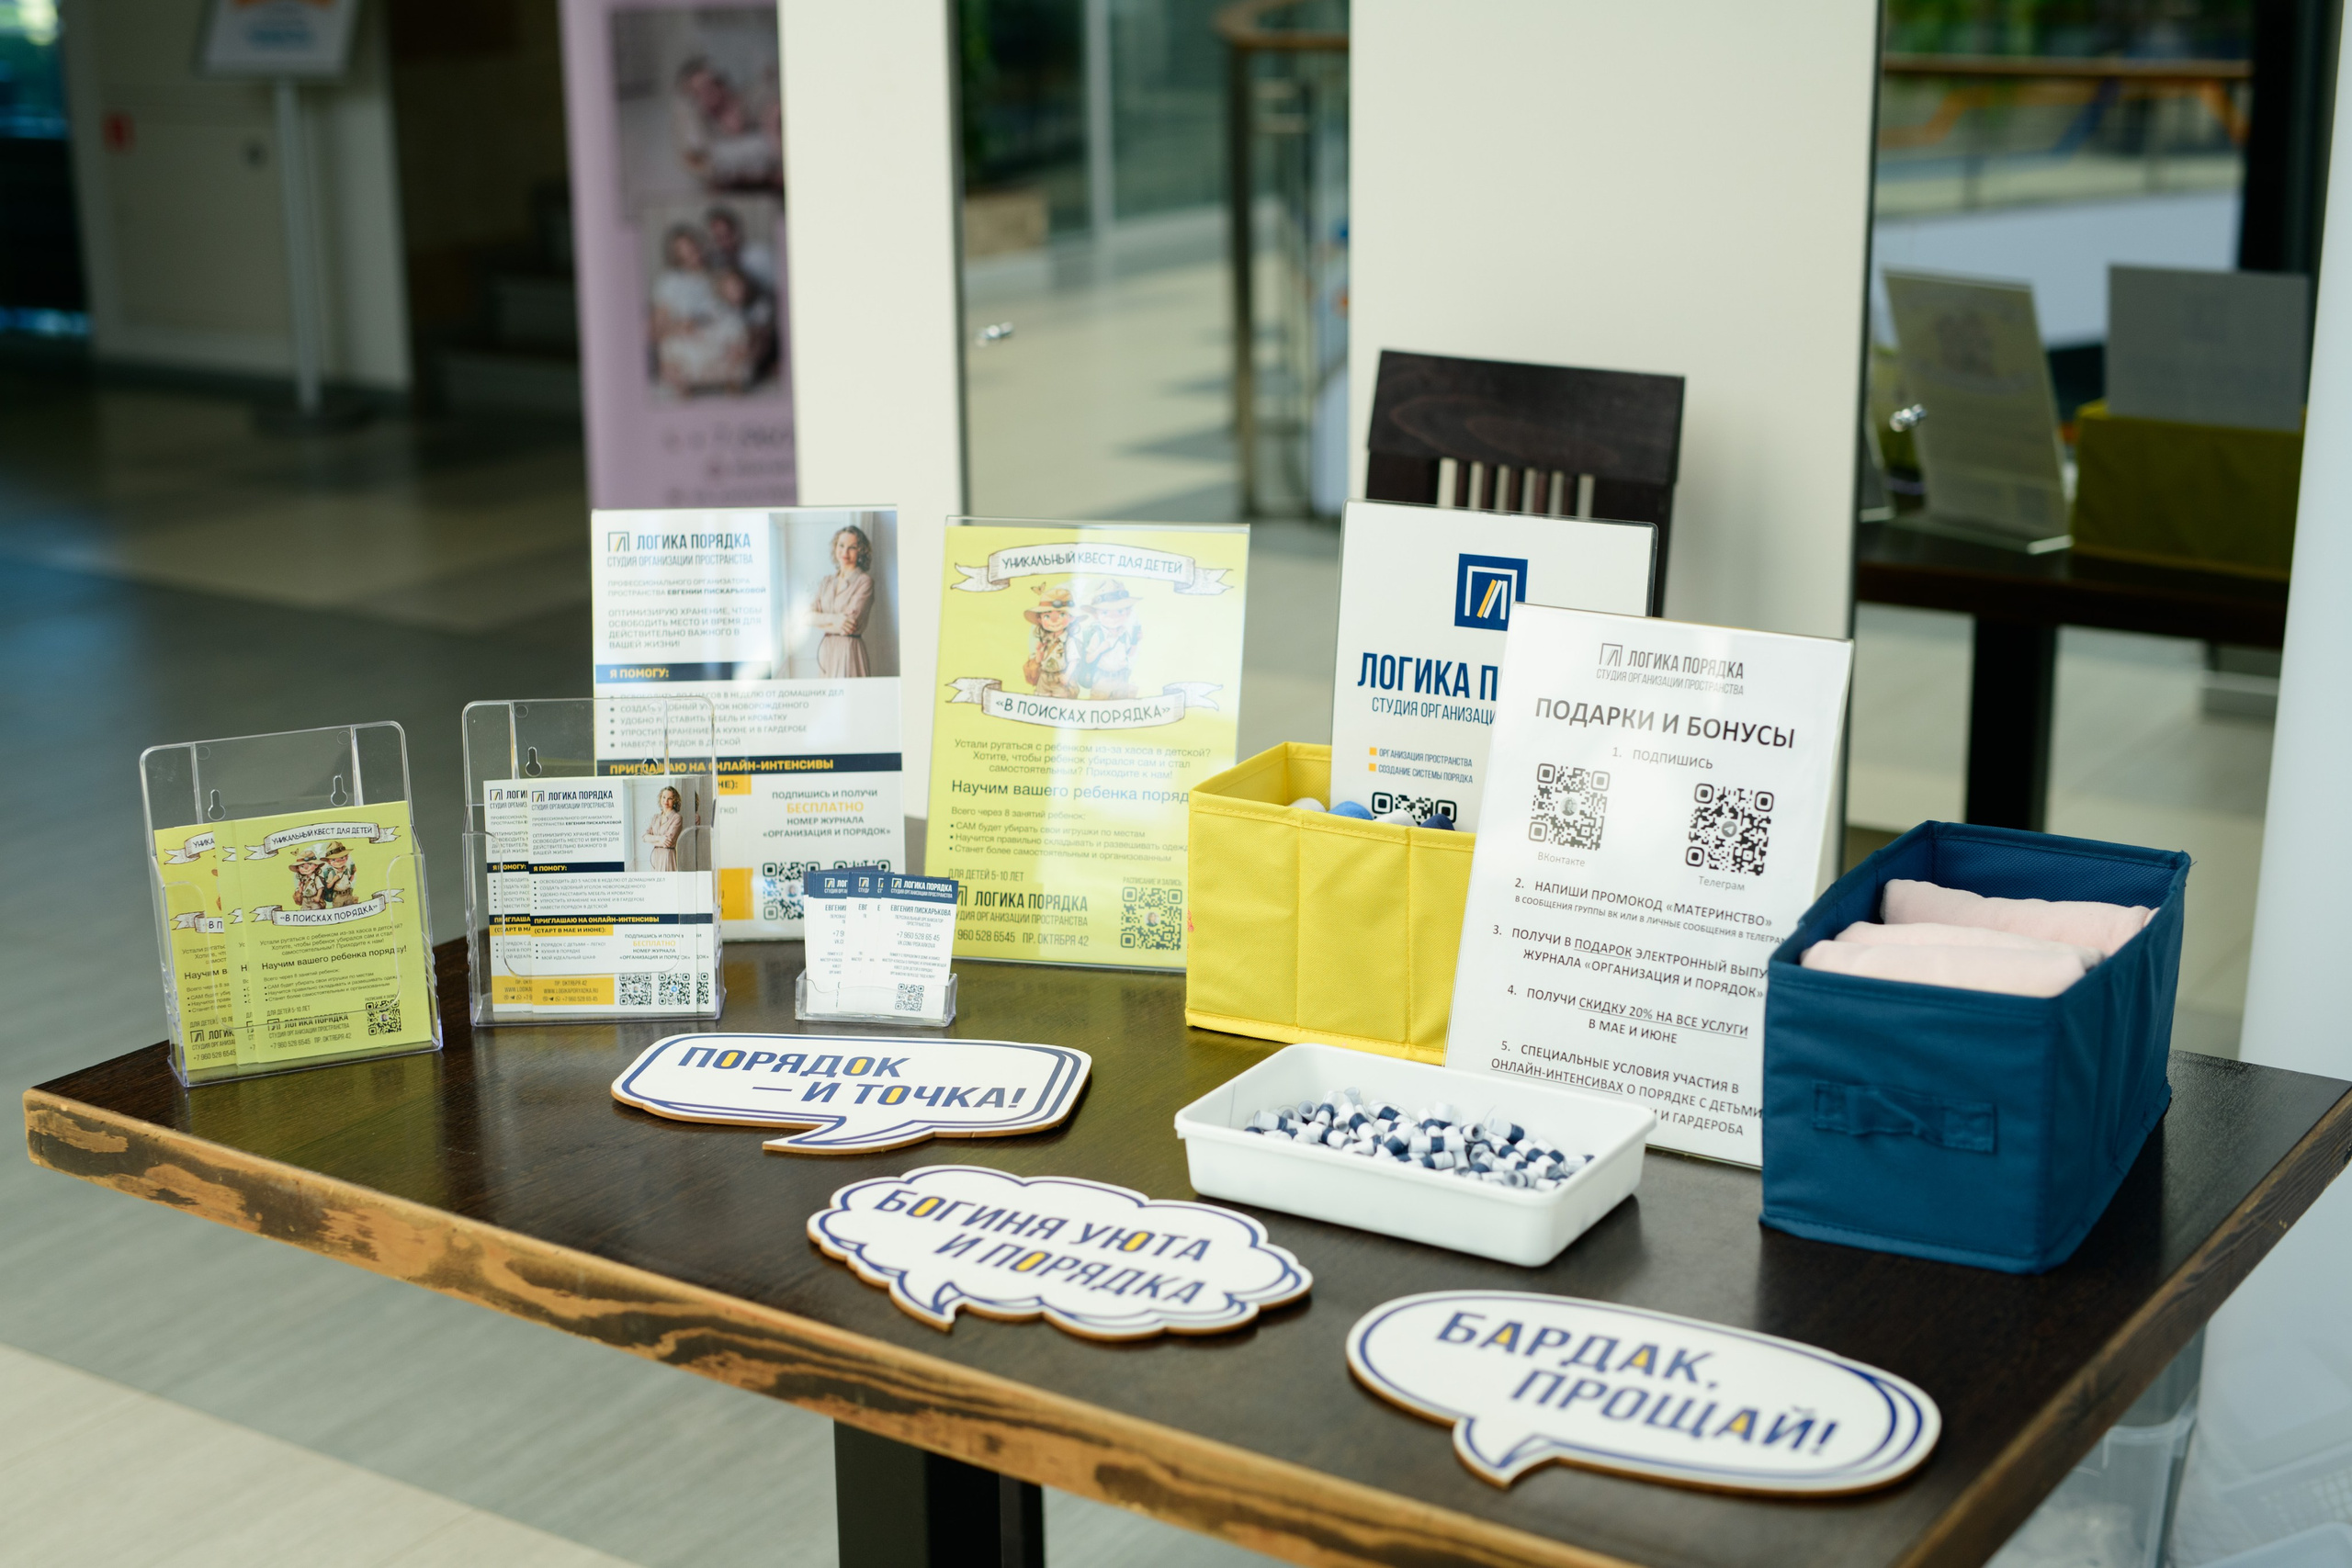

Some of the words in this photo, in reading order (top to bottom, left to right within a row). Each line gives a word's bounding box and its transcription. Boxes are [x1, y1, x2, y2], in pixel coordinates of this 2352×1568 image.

[637, 534, 686, 550] ЛОГИКА
[692, 533, 751, 549] ПОРЯДКА
[607, 556, 637, 568] СТУДИЯ
[639, 555, 693, 567] ОРГАНИЗАЦИИ
[695, 555, 752, 566] ПРОСТРАНСТВА
[1002, 551, 1075, 570] УНИКАЛЬНЫЙ
[1078, 552, 1114, 566] КВЕСТ
[1117, 556, 1142, 570] ДЛЯ
[1145, 558, 1182, 574] ДЕТЕЙ
[610, 670, 617, 678] Я
[620, 668, 669, 678] ПОМОГУ:
[1358, 652, 1470, 699] ЛОГИКА
[1628, 650, 1679, 672] ЛОГИКА
[1682, 656, 1743, 680] ПОРЯДКА
[1597, 669, 1626, 682] СТУДИЯ
[1628, 672, 1683, 688] ОРГАНИЗАЦИИ
[1685, 679, 1743, 695] ПРОСТРАНСТВА
[996, 698, 1013, 711] «В
[1017, 701, 1086, 723] ПОИСКАХ
[1091, 706, 1170, 724] ПОРЯДКА»
[1372, 697, 1418, 716] СТУДИЯ
[1420, 703, 1496, 726] ОРГАНИЗАЦИ
[1535, 698, 1654, 731] ПОДАРКИ
[1662, 713, 1678, 734] И
[1687, 716, 1794, 748] БОНУСЫ
[689, 762, 706, 773] НА
[1379, 748, 1423, 761] ОРГАНИЗАЦИЯ
[1425, 753, 1472, 767] ПРОСТРАНСТВА
[1612, 747, 1622, 758] 1.
[1634, 750, 1713, 769] ПОДПИШИСЬ
[1378, 764, 1410, 776] СОЗДАНИЕ
[1412, 768, 1442, 780] СИСТЕМЫ
[1443, 772, 1473, 784] ПОРЯДКА
[548, 792, 577, 800] ЛОГИКА
[579, 791, 613, 800] ПОРЯДКА
[772, 791, 830, 799] ПОДПИШИСЬ
[952, 780, 1008, 796] Научим
[1013, 784, 1068, 796] вашего
[1074, 786, 1136, 801] ребенка
[1142, 789, 1189, 804] поряд
[786, 802, 864, 813] БЕСПЛАТНО
[272, 829, 314, 844] УНИКАЛЬНЫЙ
[314, 827, 335, 836] КВЕСТ
[352, 826, 372, 834] ДЕТЕЙ
[763, 829, 831, 838] «ОРГАНИЗАЦИЯ
[834, 829, 841, 837] И
[843, 828, 890, 837] ПОРЯДОК»
[1538, 852, 1585, 867] ВКонтакте
[904, 881, 925, 889] ЛОГИКА
[926, 883, 952, 892] ПОРЯДКА
[948, 869, 964, 879] ДЛЯ
[966, 870, 989, 880] ДЕТЕЙ
[991, 871, 1010, 881] 5-10
[1012, 871, 1023, 881] ЛЕТ
[1699, 875, 1745, 892] Телеграм
[890, 905, 913, 913] ЕВГЕНИЯ
[914, 907, 951, 916] ПИСКАРЬКОВА
[975, 891, 1023, 908] ЛОГИКА
[1029, 894, 1088, 911] ПОРЯДКА
[1515, 878, 1524, 889] 2.
[1535, 881, 1588, 899] НАПИШИ
[1591, 889, 1662, 910] ПРОМОКОД
[1667, 900, 1771, 927] «МАТЕРИНСТВО»
[280, 914, 290, 922] «В
[293, 913, 332, 922] ПОИСКАХ
[334, 904, 378, 921] ПОРЯДКА»
[956, 911, 975, 921] УДИЯ
[977, 912, 1029, 924] ОРГАНИЗАЦИИ
[1032, 914, 1088, 926] ПРОСТРАНСТВА
[1522, 897, 1572, 911] СООБЩЕНИЯ
[1575, 905, 1606, 917] ГРУППЫ
[1608, 909, 1618, 919] ВК
[1620, 911, 1636, 921] ИЛИ
[1640, 915, 1645, 923] В
[1646, 916, 1680, 929] ЛИЧНЫЕ
[1683, 921, 1736, 937] СООБЩЕНИЯ
[1738, 930, 1743, 939] В
[957, 930, 974, 941] 960
[976, 931, 991, 942] 528
[994, 931, 1015, 942] 6545
[1023, 932, 1035, 944] ПР.
[1038, 933, 1076, 946] ОКТЯБРЯ
[1079, 935, 1089, 946] 42
[262, 960, 294, 972] Научим
[297, 956, 328, 966] вашего
[332, 950, 366, 964] ребенка
[1493, 925, 1501, 936] 3.
[1511, 928, 1562, 946] ПОЛУЧИ
[1565, 936, 1571, 948] В
[1575, 938, 1632, 957] ПОДАРОК
[1635, 947, 1726, 973] ЭЛЕКТРОННЫЙ
[1730, 963, 1768, 979] ВЫПУ
[1523, 950, 1580, 969] ЖУРНАЛА
[1585, 959, 1679, 985] «ОРГАНИЗАЦИЯ
[1683, 975, 1691, 987] И
[1695, 977, 1763, 998] ПОРЯДОК»
[1508, 985, 1517, 997] 4.
[1527, 988, 1576, 1007] ПОЛУЧИ
[1579, 998, 1626, 1015] СКИДКУ
[1629, 1006, 1652, 1020] 20%
[1657, 1010, 1672, 1023] НА
[1677, 1014, 1698, 1028] ВСЕ
[1702, 1018, 1748, 1036] УСЛУГИ
[1589, 1019, 1595, 1030] В
[1600, 1021, 1625, 1034] МАЕ
[1629, 1025, 1636, 1036] И
[1641, 1028, 1678, 1043] ИЮНЕ
[678, 1046, 910, 1078] ПОРЯДОК
[1501, 1041, 1510, 1052] 5.
[1521, 1044, 1609, 1070] СПЕЦИАЛЬНЫЕ
[1612, 1061, 1668, 1081] УСЛОВИЯ
[1673, 1071, 1727, 1091] УЧАСТИЯ
[1732, 1082, 1738, 1094] В
[801, 1083, 839, 1103] И
[854, 1084, 1027, 1109] ТОЧКА!
[1491, 1058, 1623, 1093] ОНЛАЙН-ИНТЕНСИВАХ
[1627, 1083, 1635, 1095] О
[1639, 1085, 1695, 1107] ПОРЯДКЕ
[1700, 1096, 1706, 1109] С
[1709, 1098, 1762, 1119] ДЕТЬМИ
[1661, 1110, 1668, 1121] И
[1673, 1112, 1743, 1136] ГАРДЕРОБА
[874, 1189, 1069, 1240] БОГИНЯ
[1069, 1223, 1212, 1262] УЮТА
[934, 1233, 977, 1256] И
[977, 1244, 1205, 1305] ПОРЯДКА
[1437, 1310, 1717, 1390] БАРДАК,
[1510, 1370, 1841, 1456] ПРОЩАЙ!
